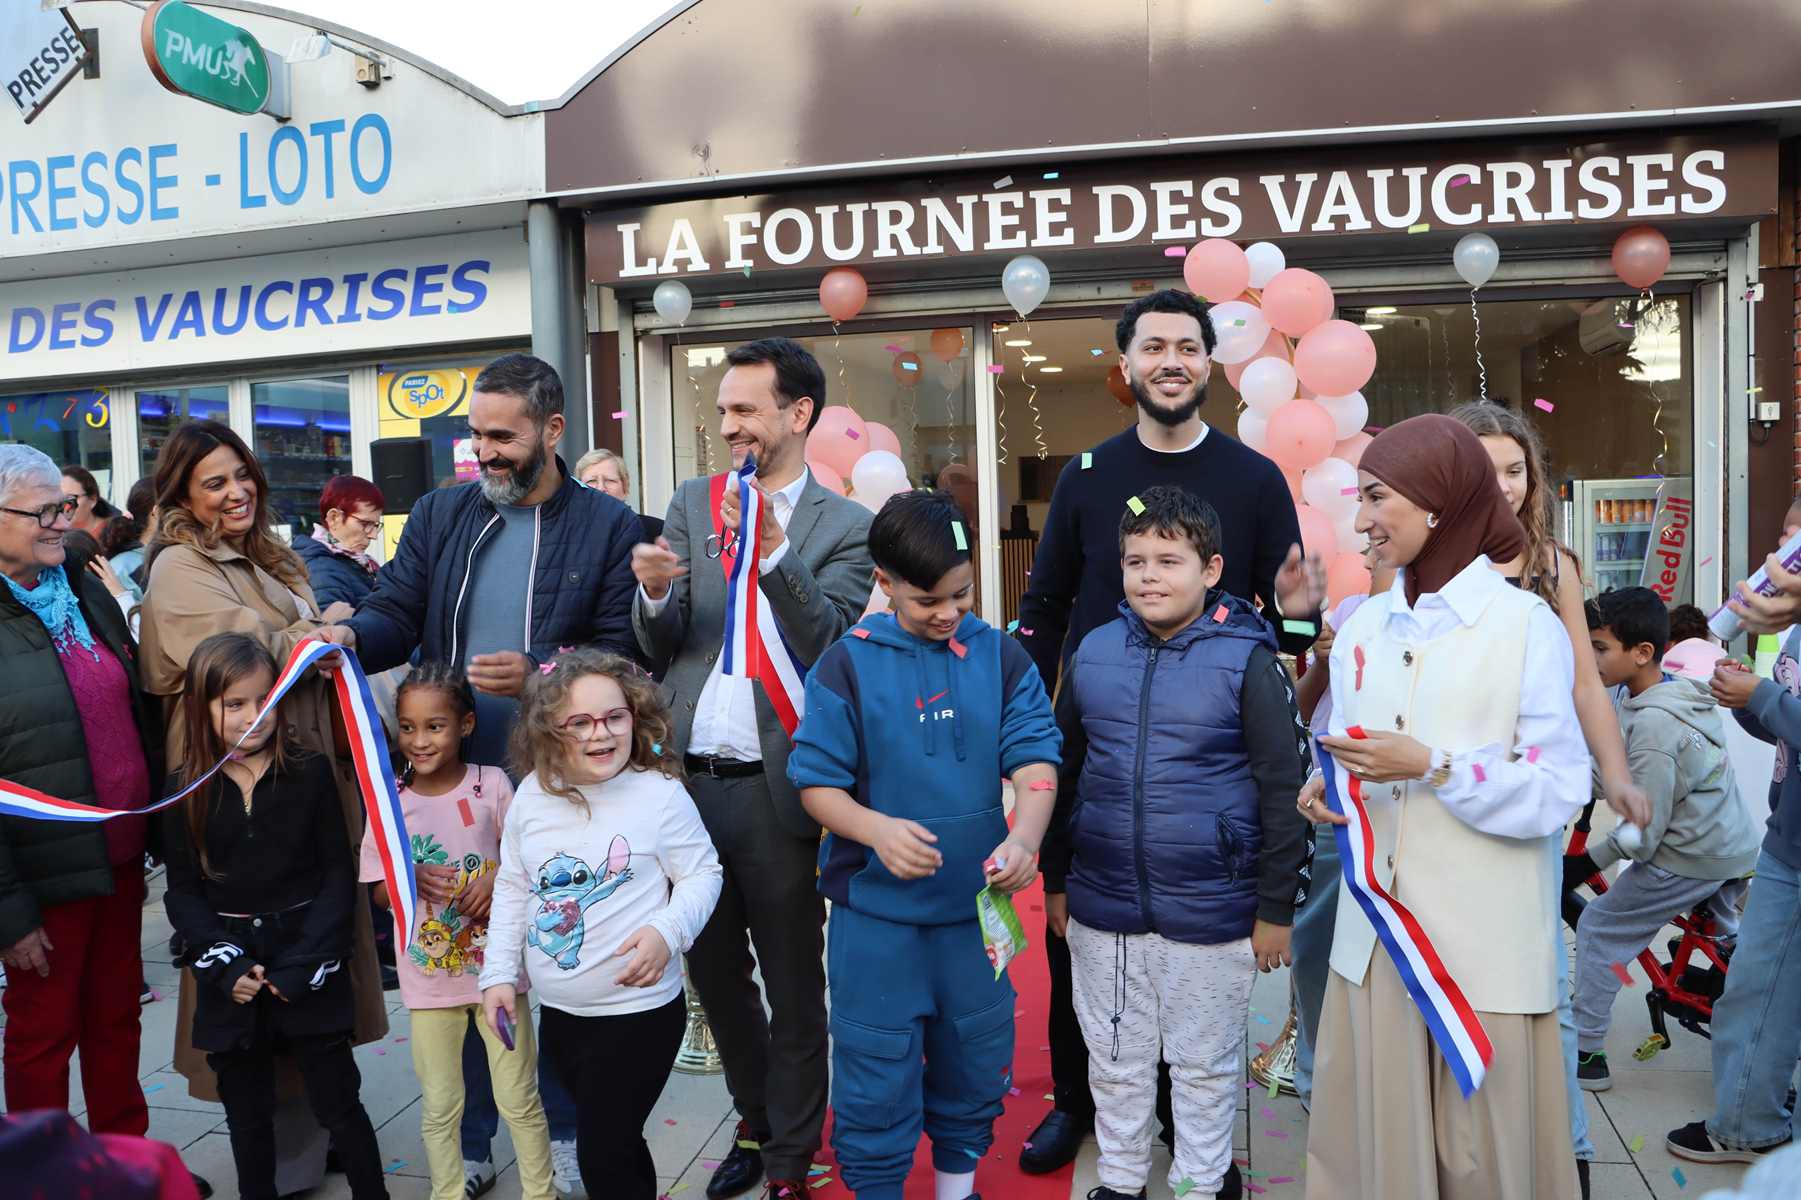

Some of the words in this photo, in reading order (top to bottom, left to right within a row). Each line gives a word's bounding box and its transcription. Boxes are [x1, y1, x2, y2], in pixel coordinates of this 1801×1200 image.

[7, 26, 81, 109] PRESSE
[164, 28, 226, 77] PMU
[0, 143, 180, 235] RESSE
[239, 112, 392, 209] LOTO
[617, 219, 710, 278] LA
[723, 175, 1075, 268] FOURNÉE
[1093, 177, 1243, 244] DES
[1259, 150, 1727, 233] VAUCRISES
[8, 299, 116, 355] DES
[135, 260, 492, 342] VAUCRISES
[1661, 496, 1692, 548] Bull
[1652, 550, 1682, 602] Red
